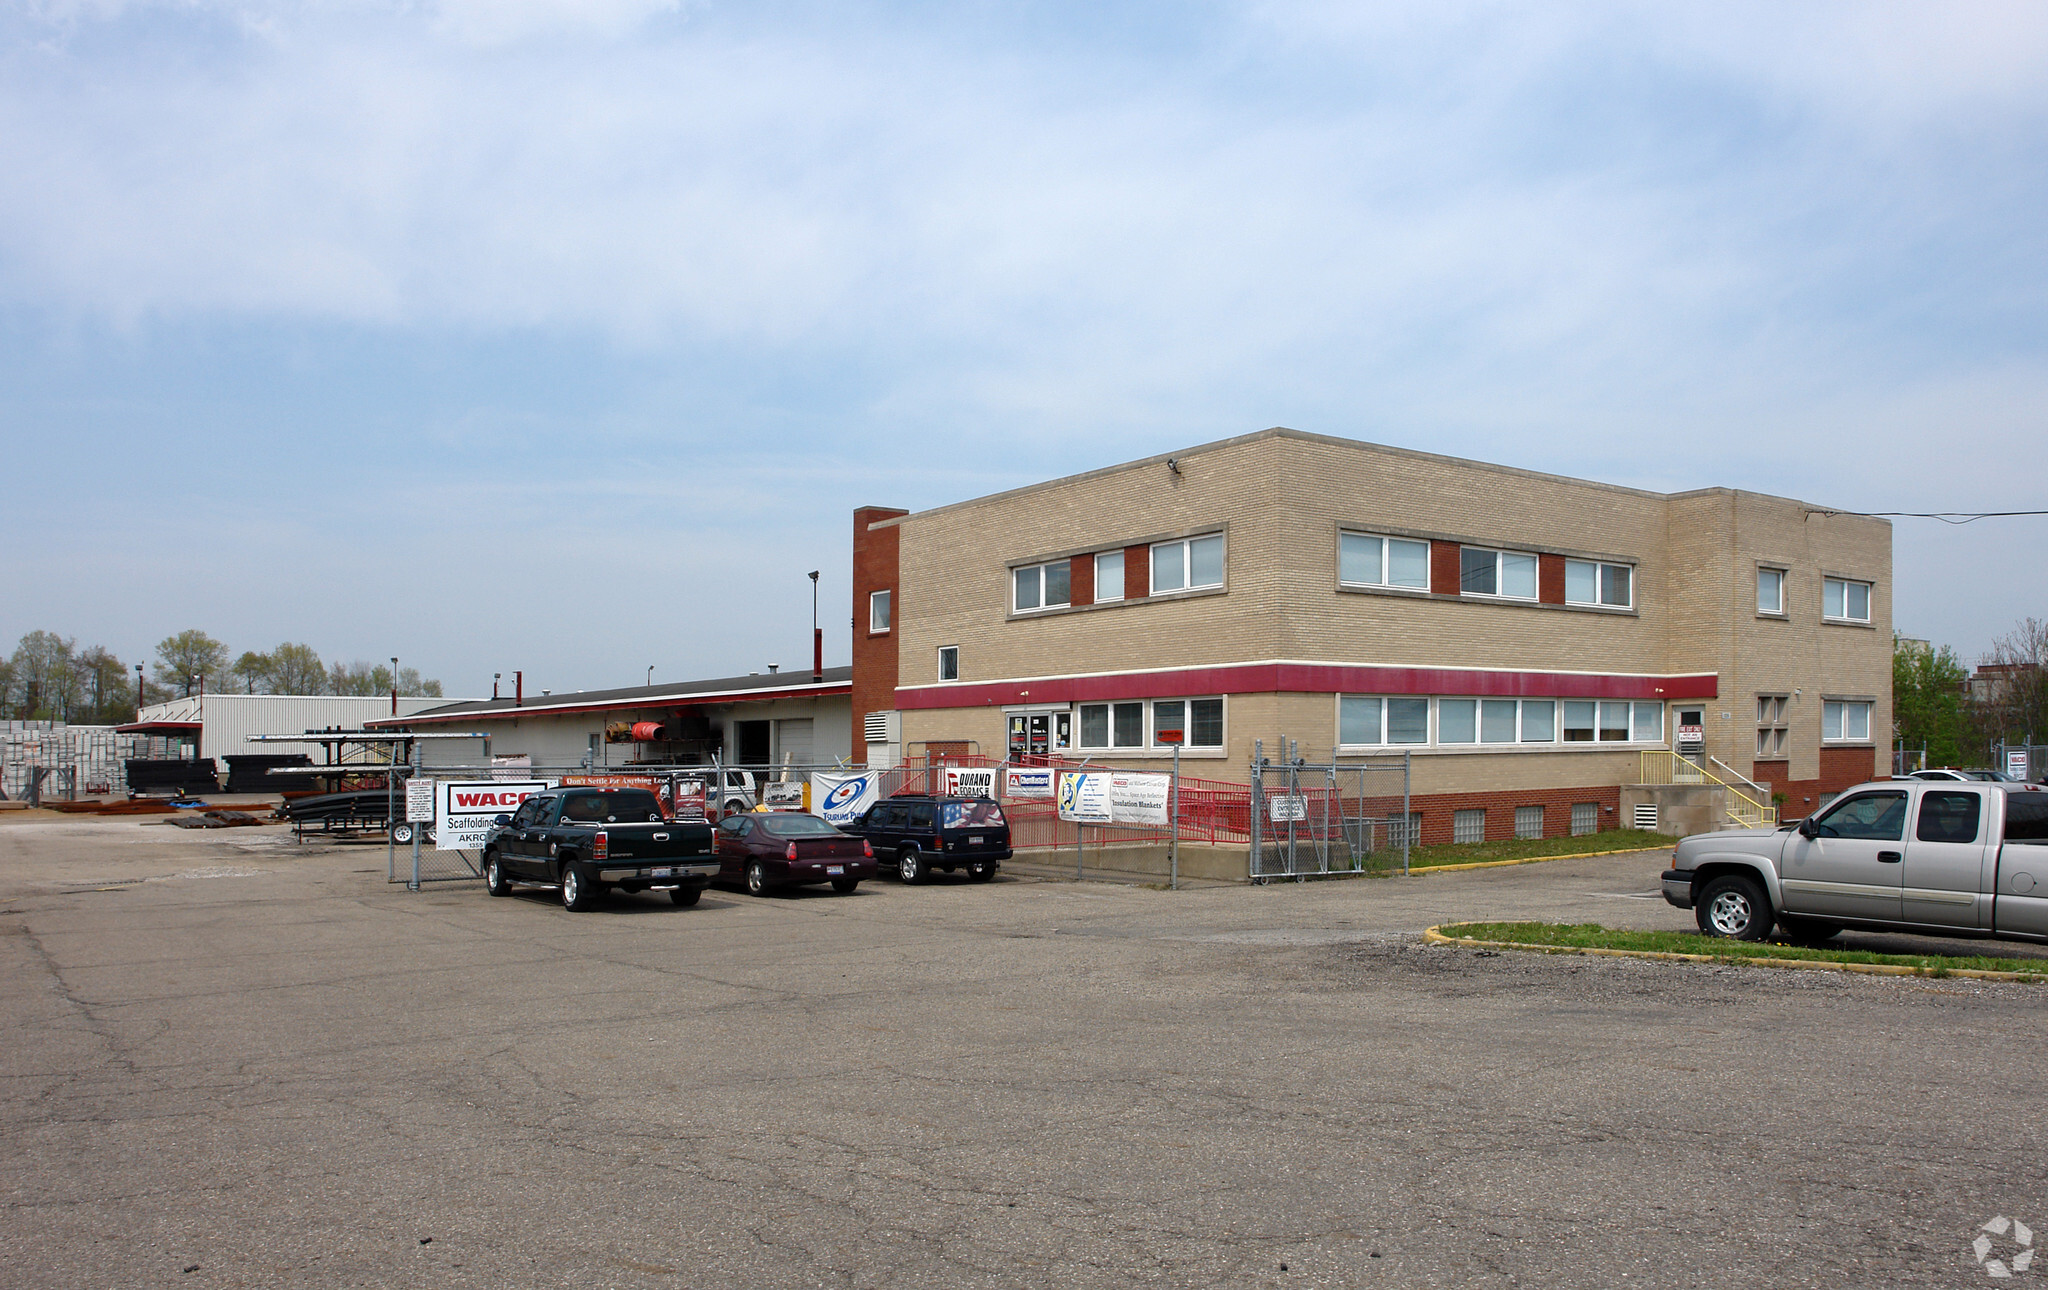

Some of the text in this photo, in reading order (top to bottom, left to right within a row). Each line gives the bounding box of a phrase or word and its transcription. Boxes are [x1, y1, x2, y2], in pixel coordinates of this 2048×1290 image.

[566, 777, 586, 785] Don't
[587, 777, 608, 785] Settle
[621, 776, 652, 785] Anything
[959, 773, 991, 786] DURAND
[959, 787, 983, 797] FORMS
[448, 817, 495, 829] Scaffolding
[458, 834, 487, 842] AKRO
